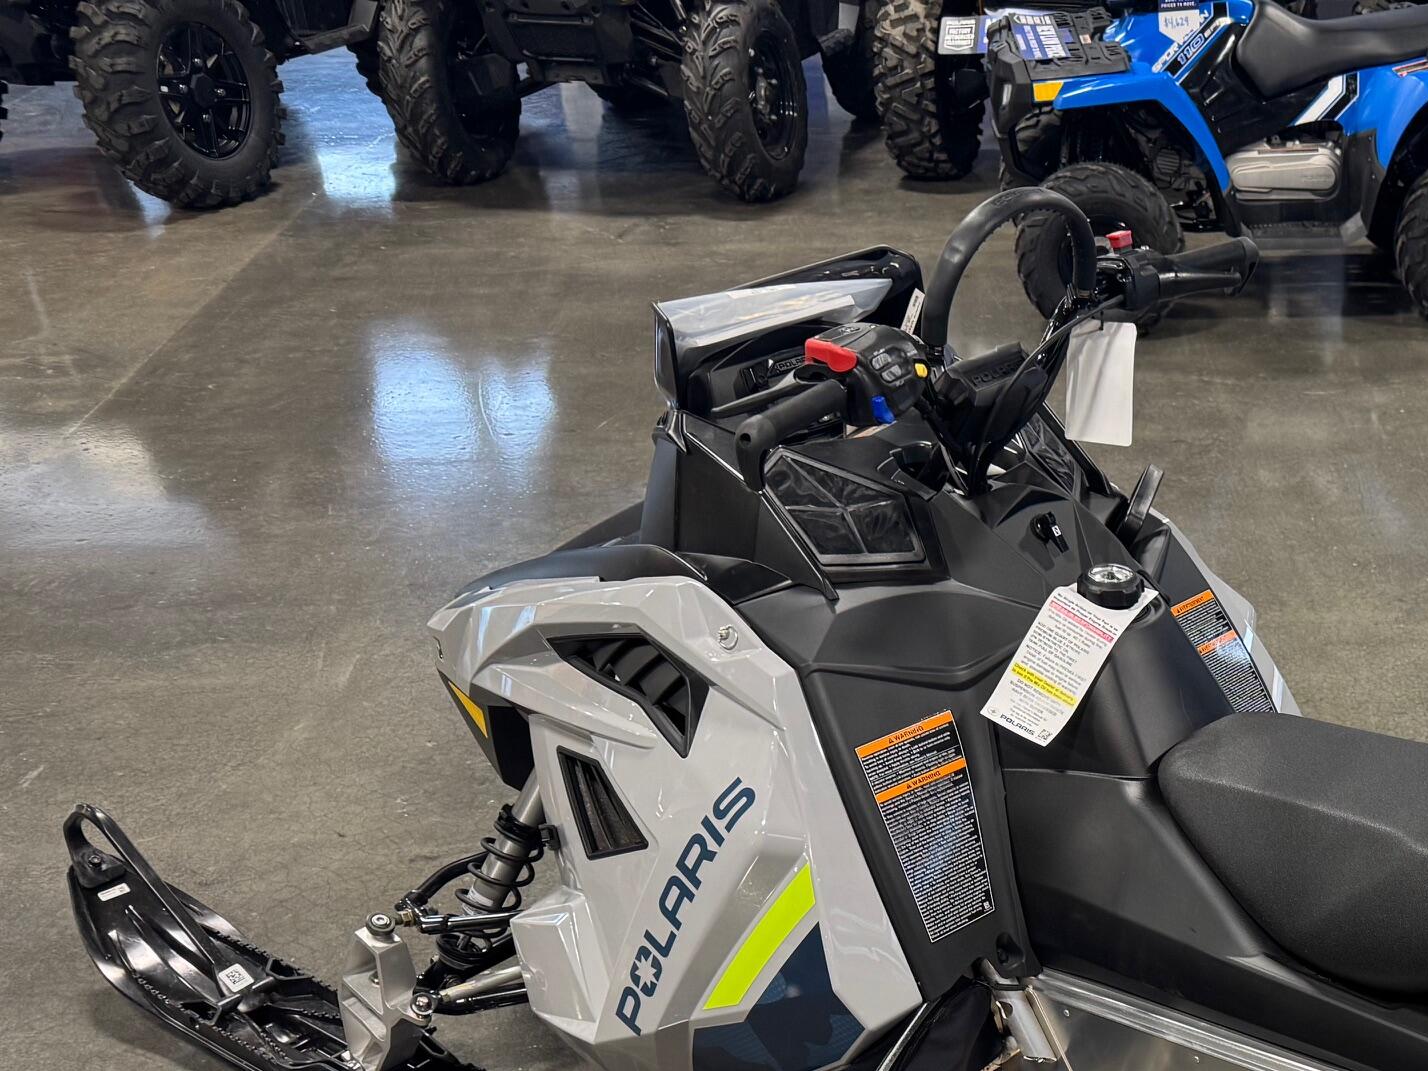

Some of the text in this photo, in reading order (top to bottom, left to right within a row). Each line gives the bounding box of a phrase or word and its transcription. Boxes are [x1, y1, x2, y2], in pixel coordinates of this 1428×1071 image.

[1177, 33, 1206, 65] 110
[893, 724, 924, 742] WARNING
[999, 713, 1036, 736] POLARIS
[911, 770, 941, 787] WARNING
[615, 776, 756, 1037] POLARIS
